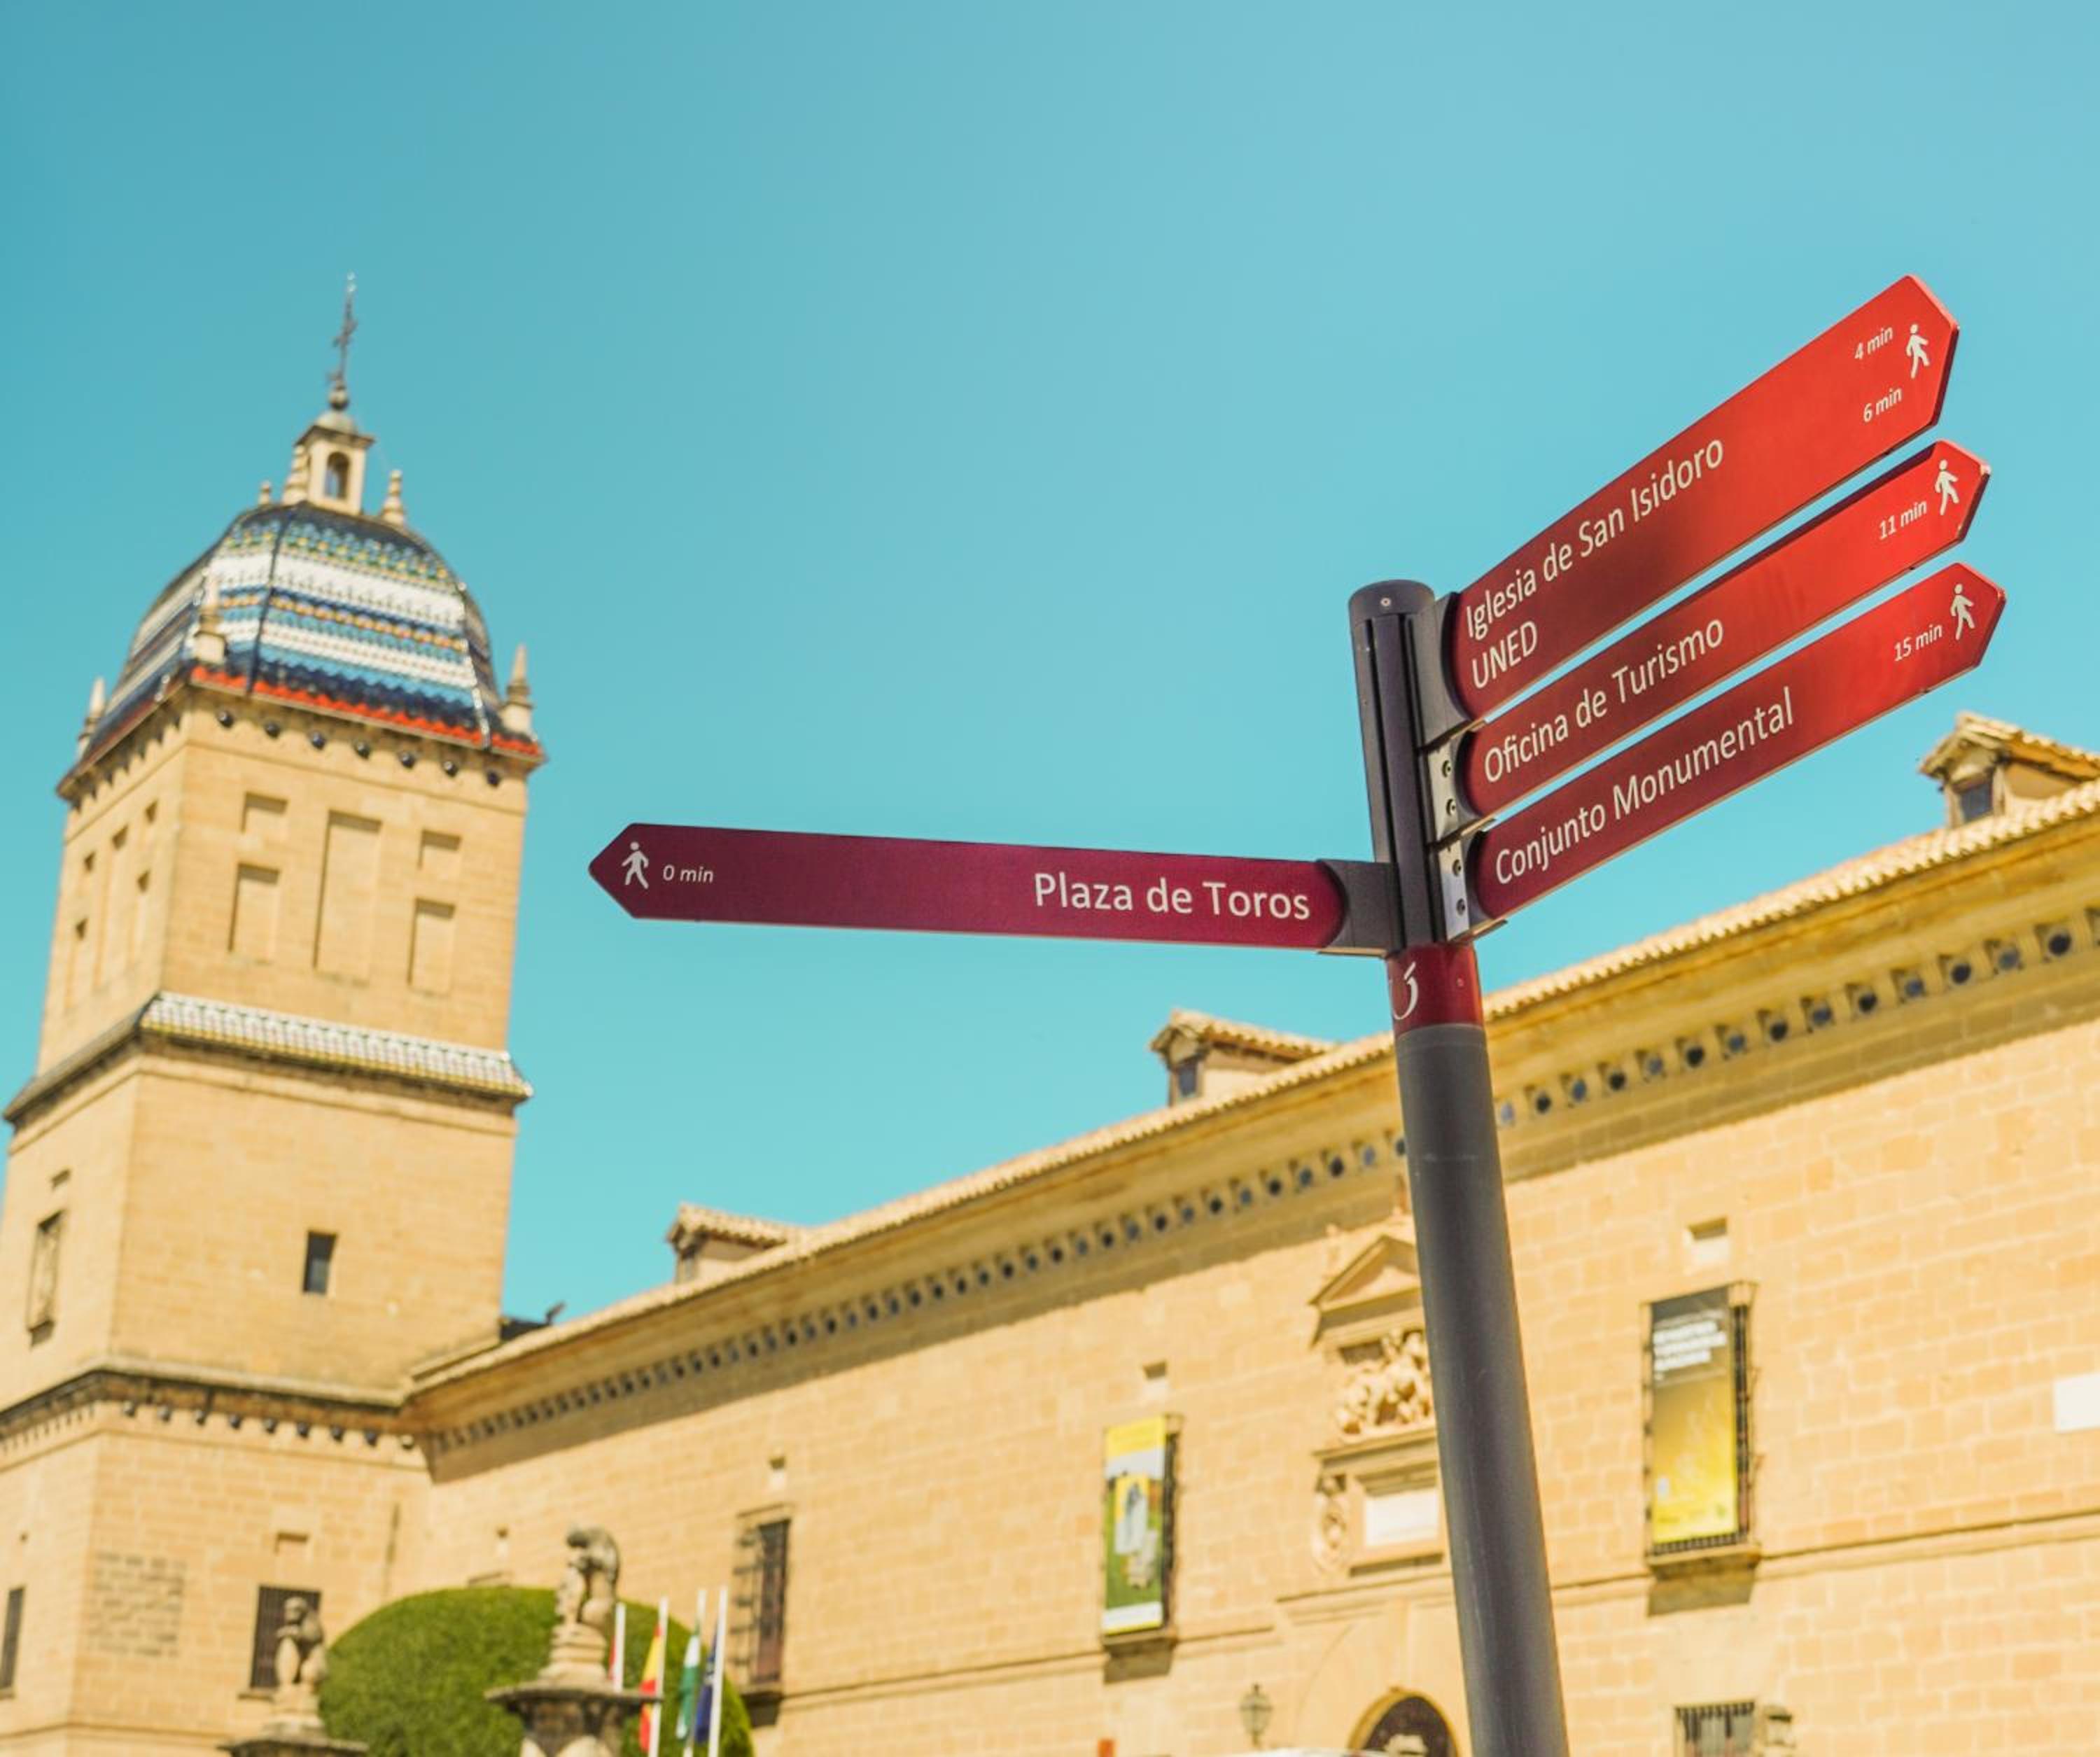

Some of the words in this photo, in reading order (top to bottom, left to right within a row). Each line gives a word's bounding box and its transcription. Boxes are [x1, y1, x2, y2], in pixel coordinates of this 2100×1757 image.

[1854, 342, 1865, 360] 4
[1867, 327, 1893, 355] min
[1863, 402, 1873, 423] 6
[1875, 386, 1903, 415] min
[1465, 568, 1537, 641] Iglesia
[1543, 542, 1574, 582] de
[1578, 507, 1625, 558] San
[1631, 439, 1723, 522] Isidoro
[1879, 514, 1897, 540] 11
[1900, 499, 1928, 528] min
[1471, 620, 1538, 689] UNED
[1893, 636, 1912, 662] 15
[1914, 622, 1942, 650] min
[1484, 714, 1569, 783] Oficina
[1575, 688, 1608, 729] de
[1611, 619, 1724, 708] Turismo
[1495, 804, 1606, 885] Conjunto
[1613, 685, 1793, 820] Monumental
[662, 864, 676, 881] 0
[680, 865, 714, 883] min
[1034, 871, 1133, 911] Plaza
[1146, 876, 1193, 914] de
[1201, 881, 1311, 920] Toros
